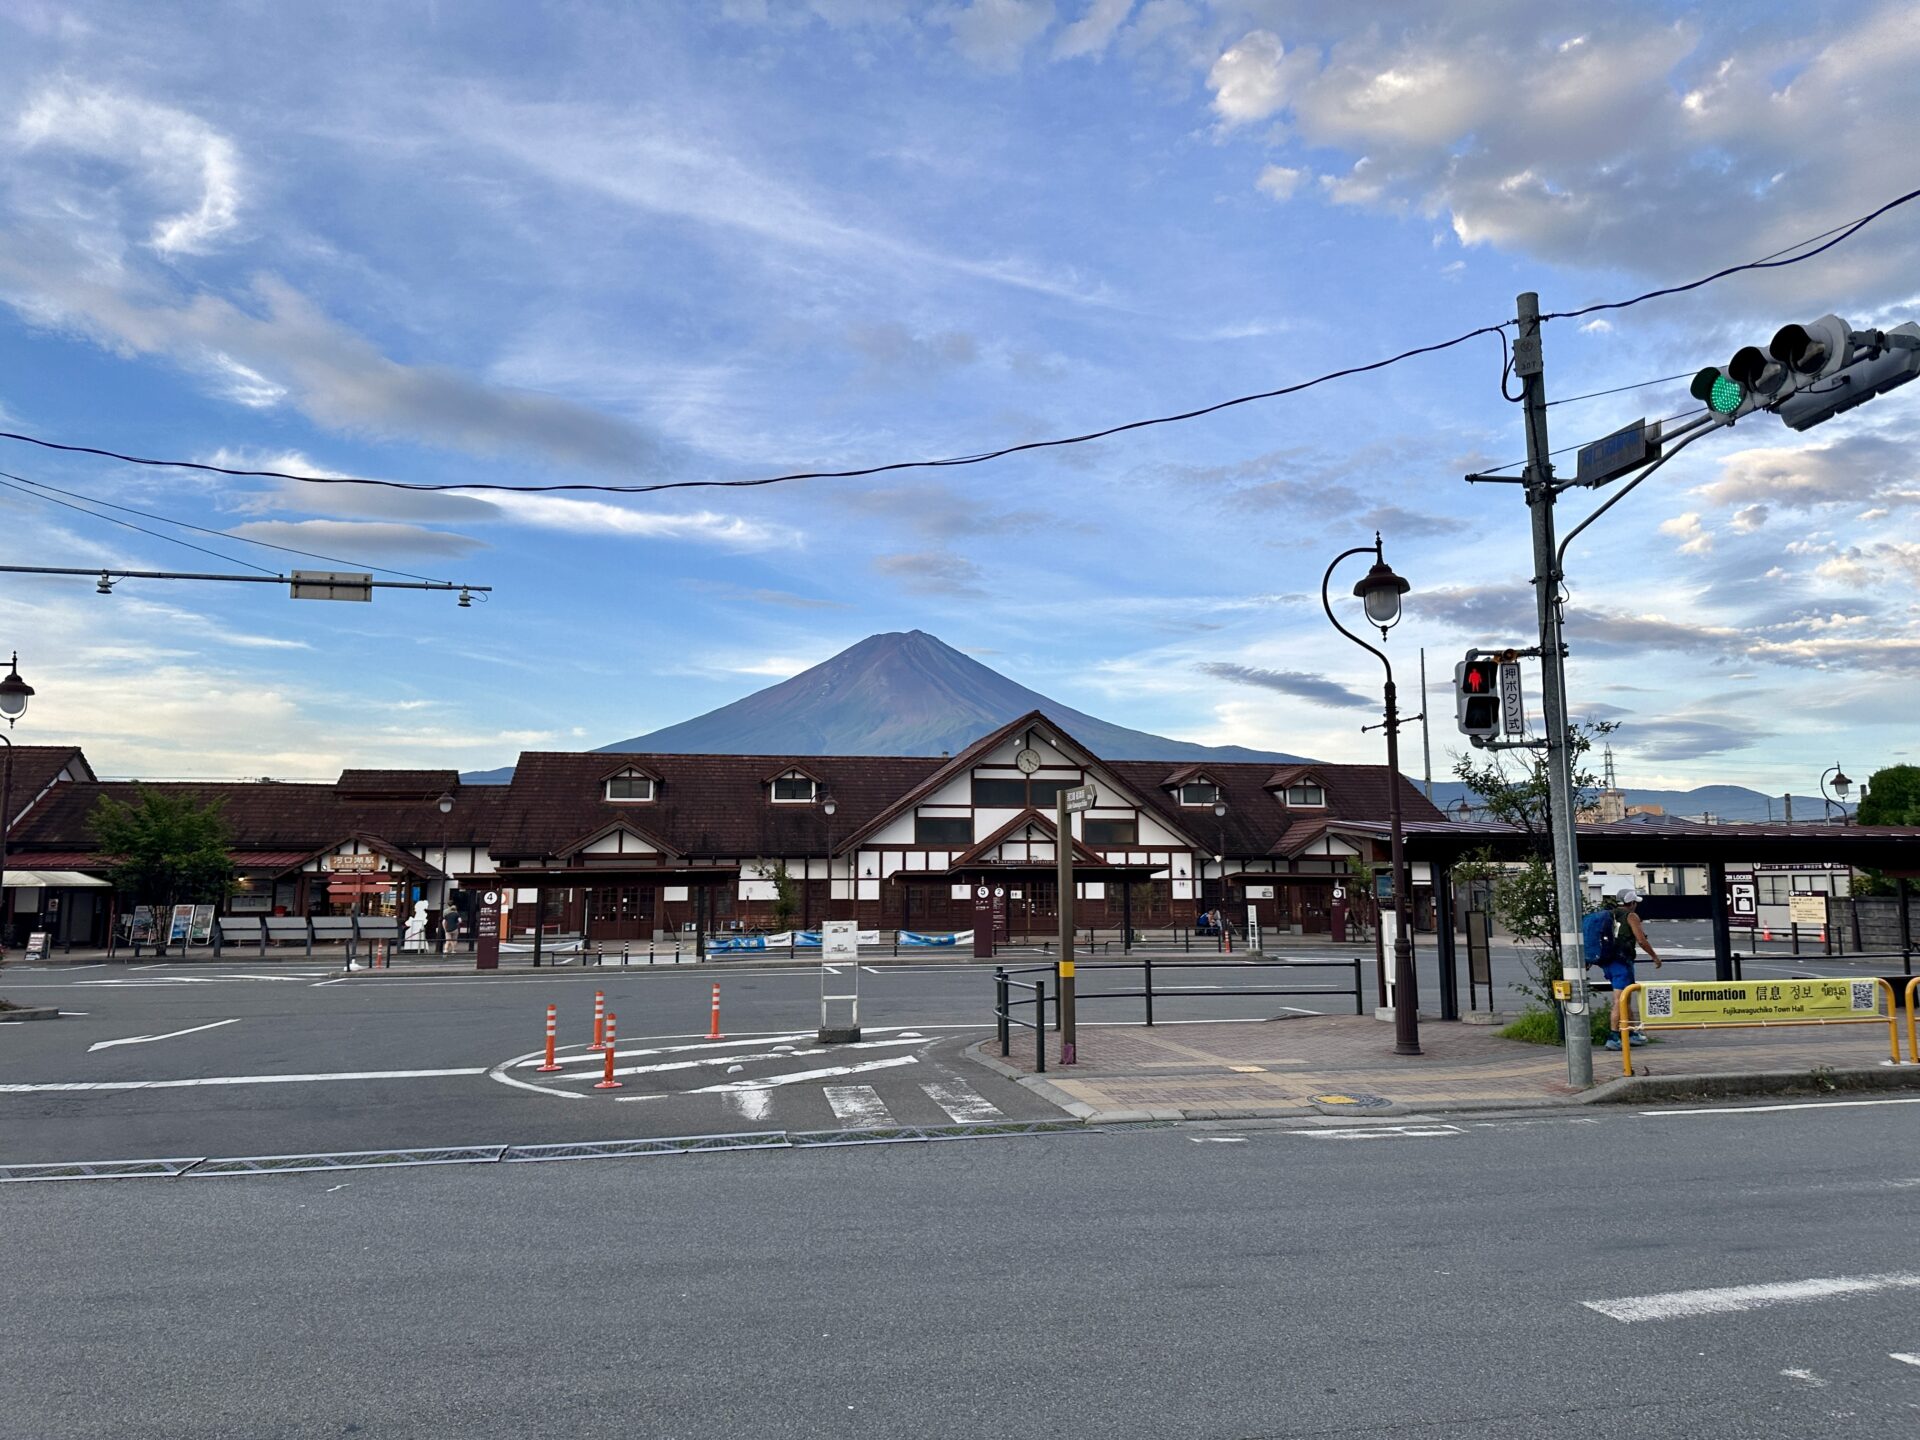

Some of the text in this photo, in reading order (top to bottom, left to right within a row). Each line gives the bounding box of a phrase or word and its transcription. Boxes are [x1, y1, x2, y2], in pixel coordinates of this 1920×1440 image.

[1505, 668, 1520, 729] 押ボタン式
[980, 888, 986, 896] 5
[1678, 982, 1847, 1002] Information 信息 정보 ข้อมูล
[1722, 1005, 1804, 1015] Fujikawaguchiko Town Hall
